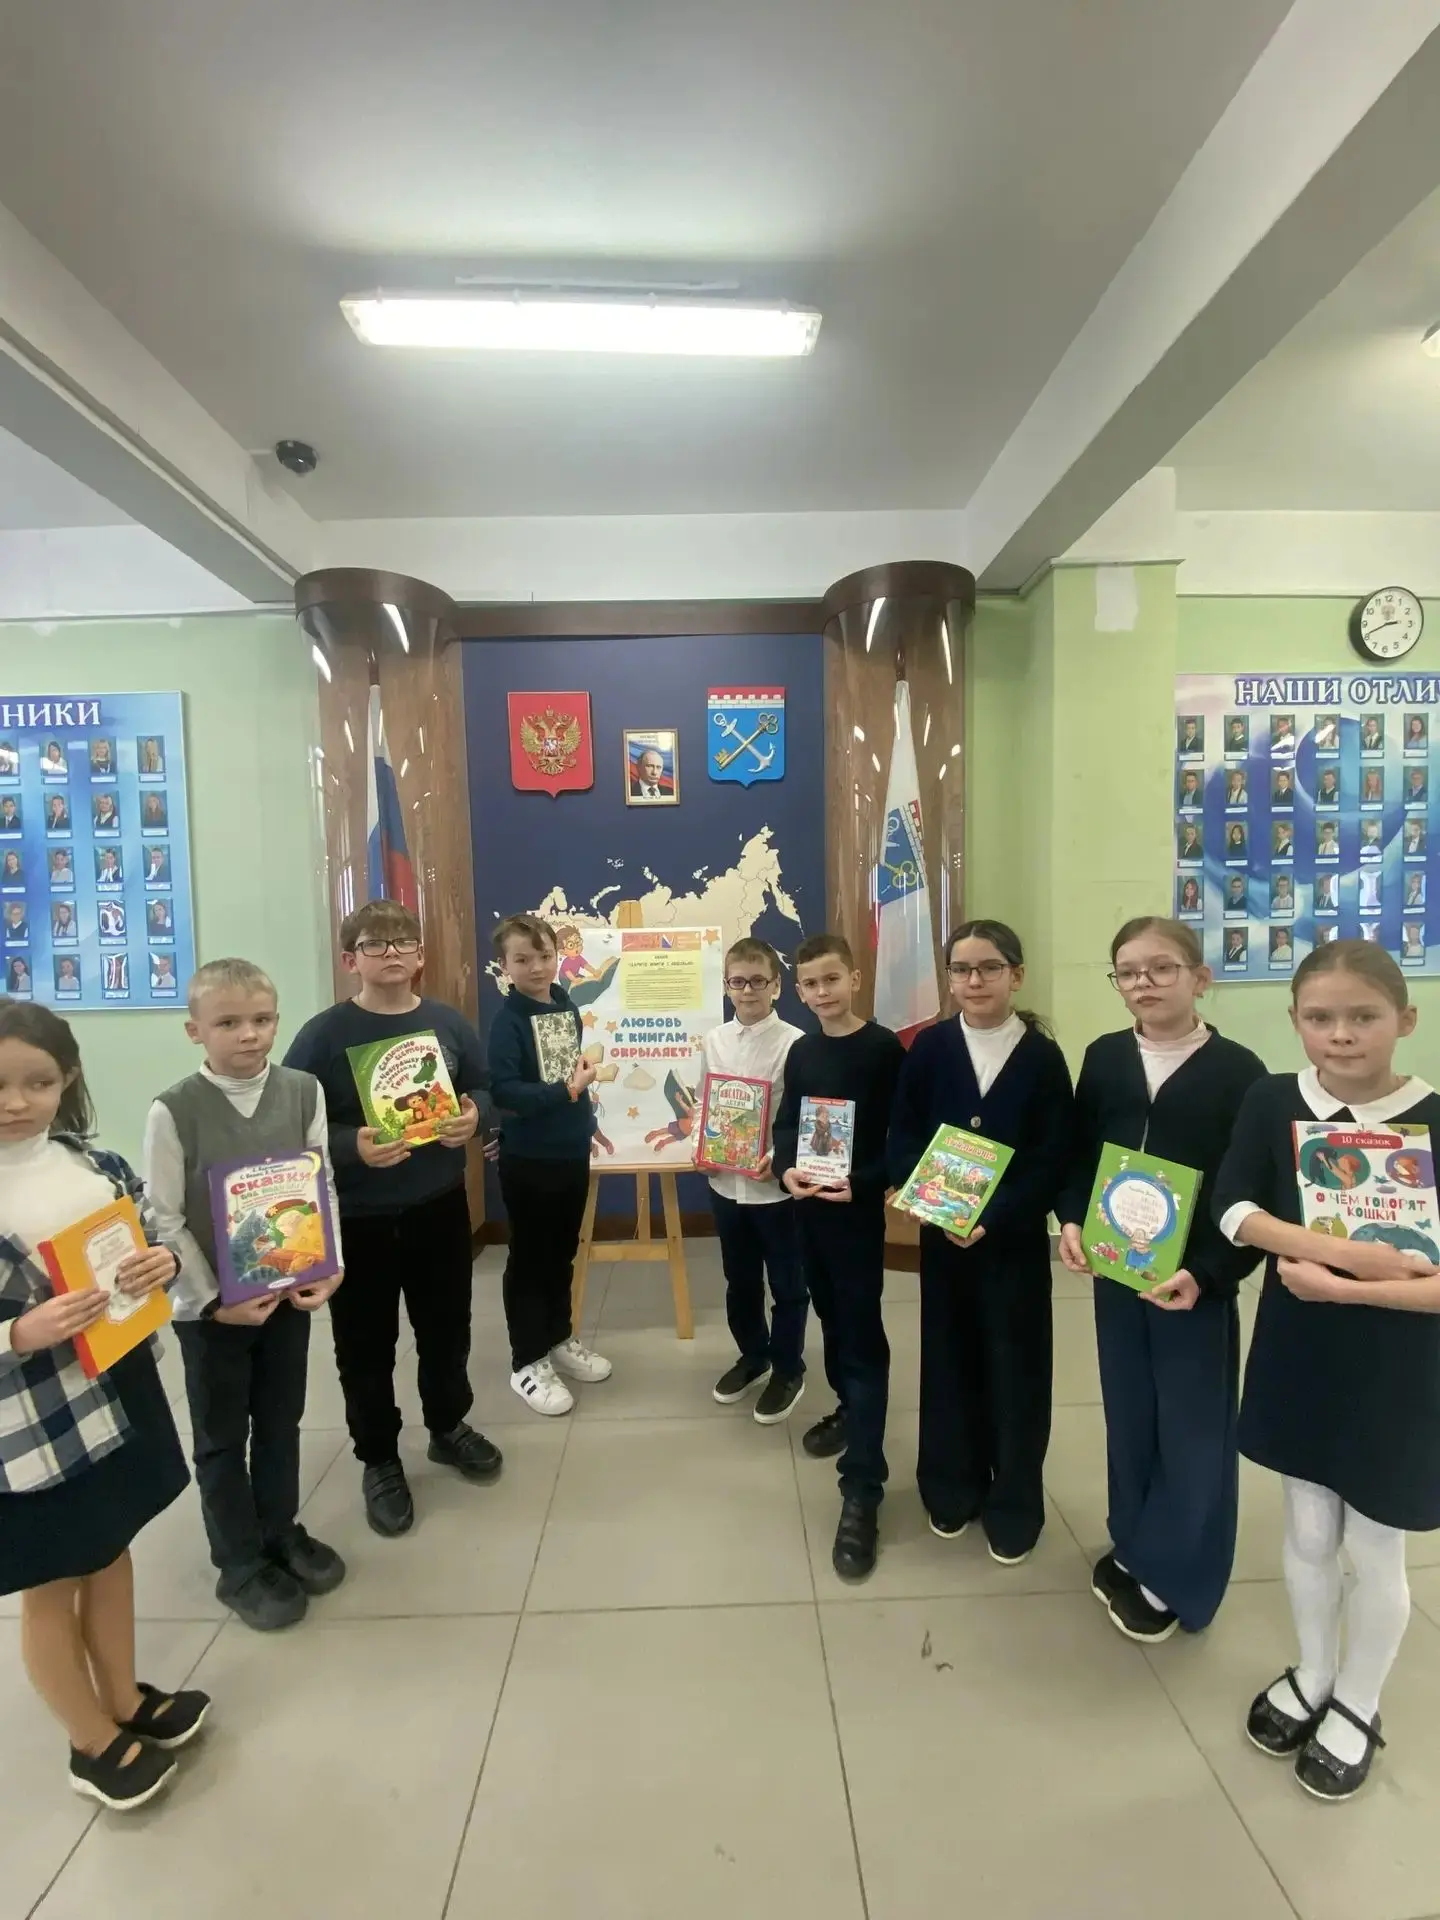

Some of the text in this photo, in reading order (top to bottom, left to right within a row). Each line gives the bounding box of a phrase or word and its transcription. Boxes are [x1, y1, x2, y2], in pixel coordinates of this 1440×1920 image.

[1236, 678, 1440, 704] НАШИ ОТЛИ
[1, 702, 101, 727] НИКИ
[621, 1017, 682, 1028] ЛЮБОВЬ
[615, 1032, 688, 1043] К КНИГАМ
[610, 1046, 692, 1058] ОКРЫЛЯЕТ!
[1341, 1135, 1391, 1147] 10 сказок
[1315, 1192, 1325, 1203] О
[1365, 1196, 1427, 1211] ГОВОРЯТ
[1347, 1207, 1397, 1222] КОШКИ
